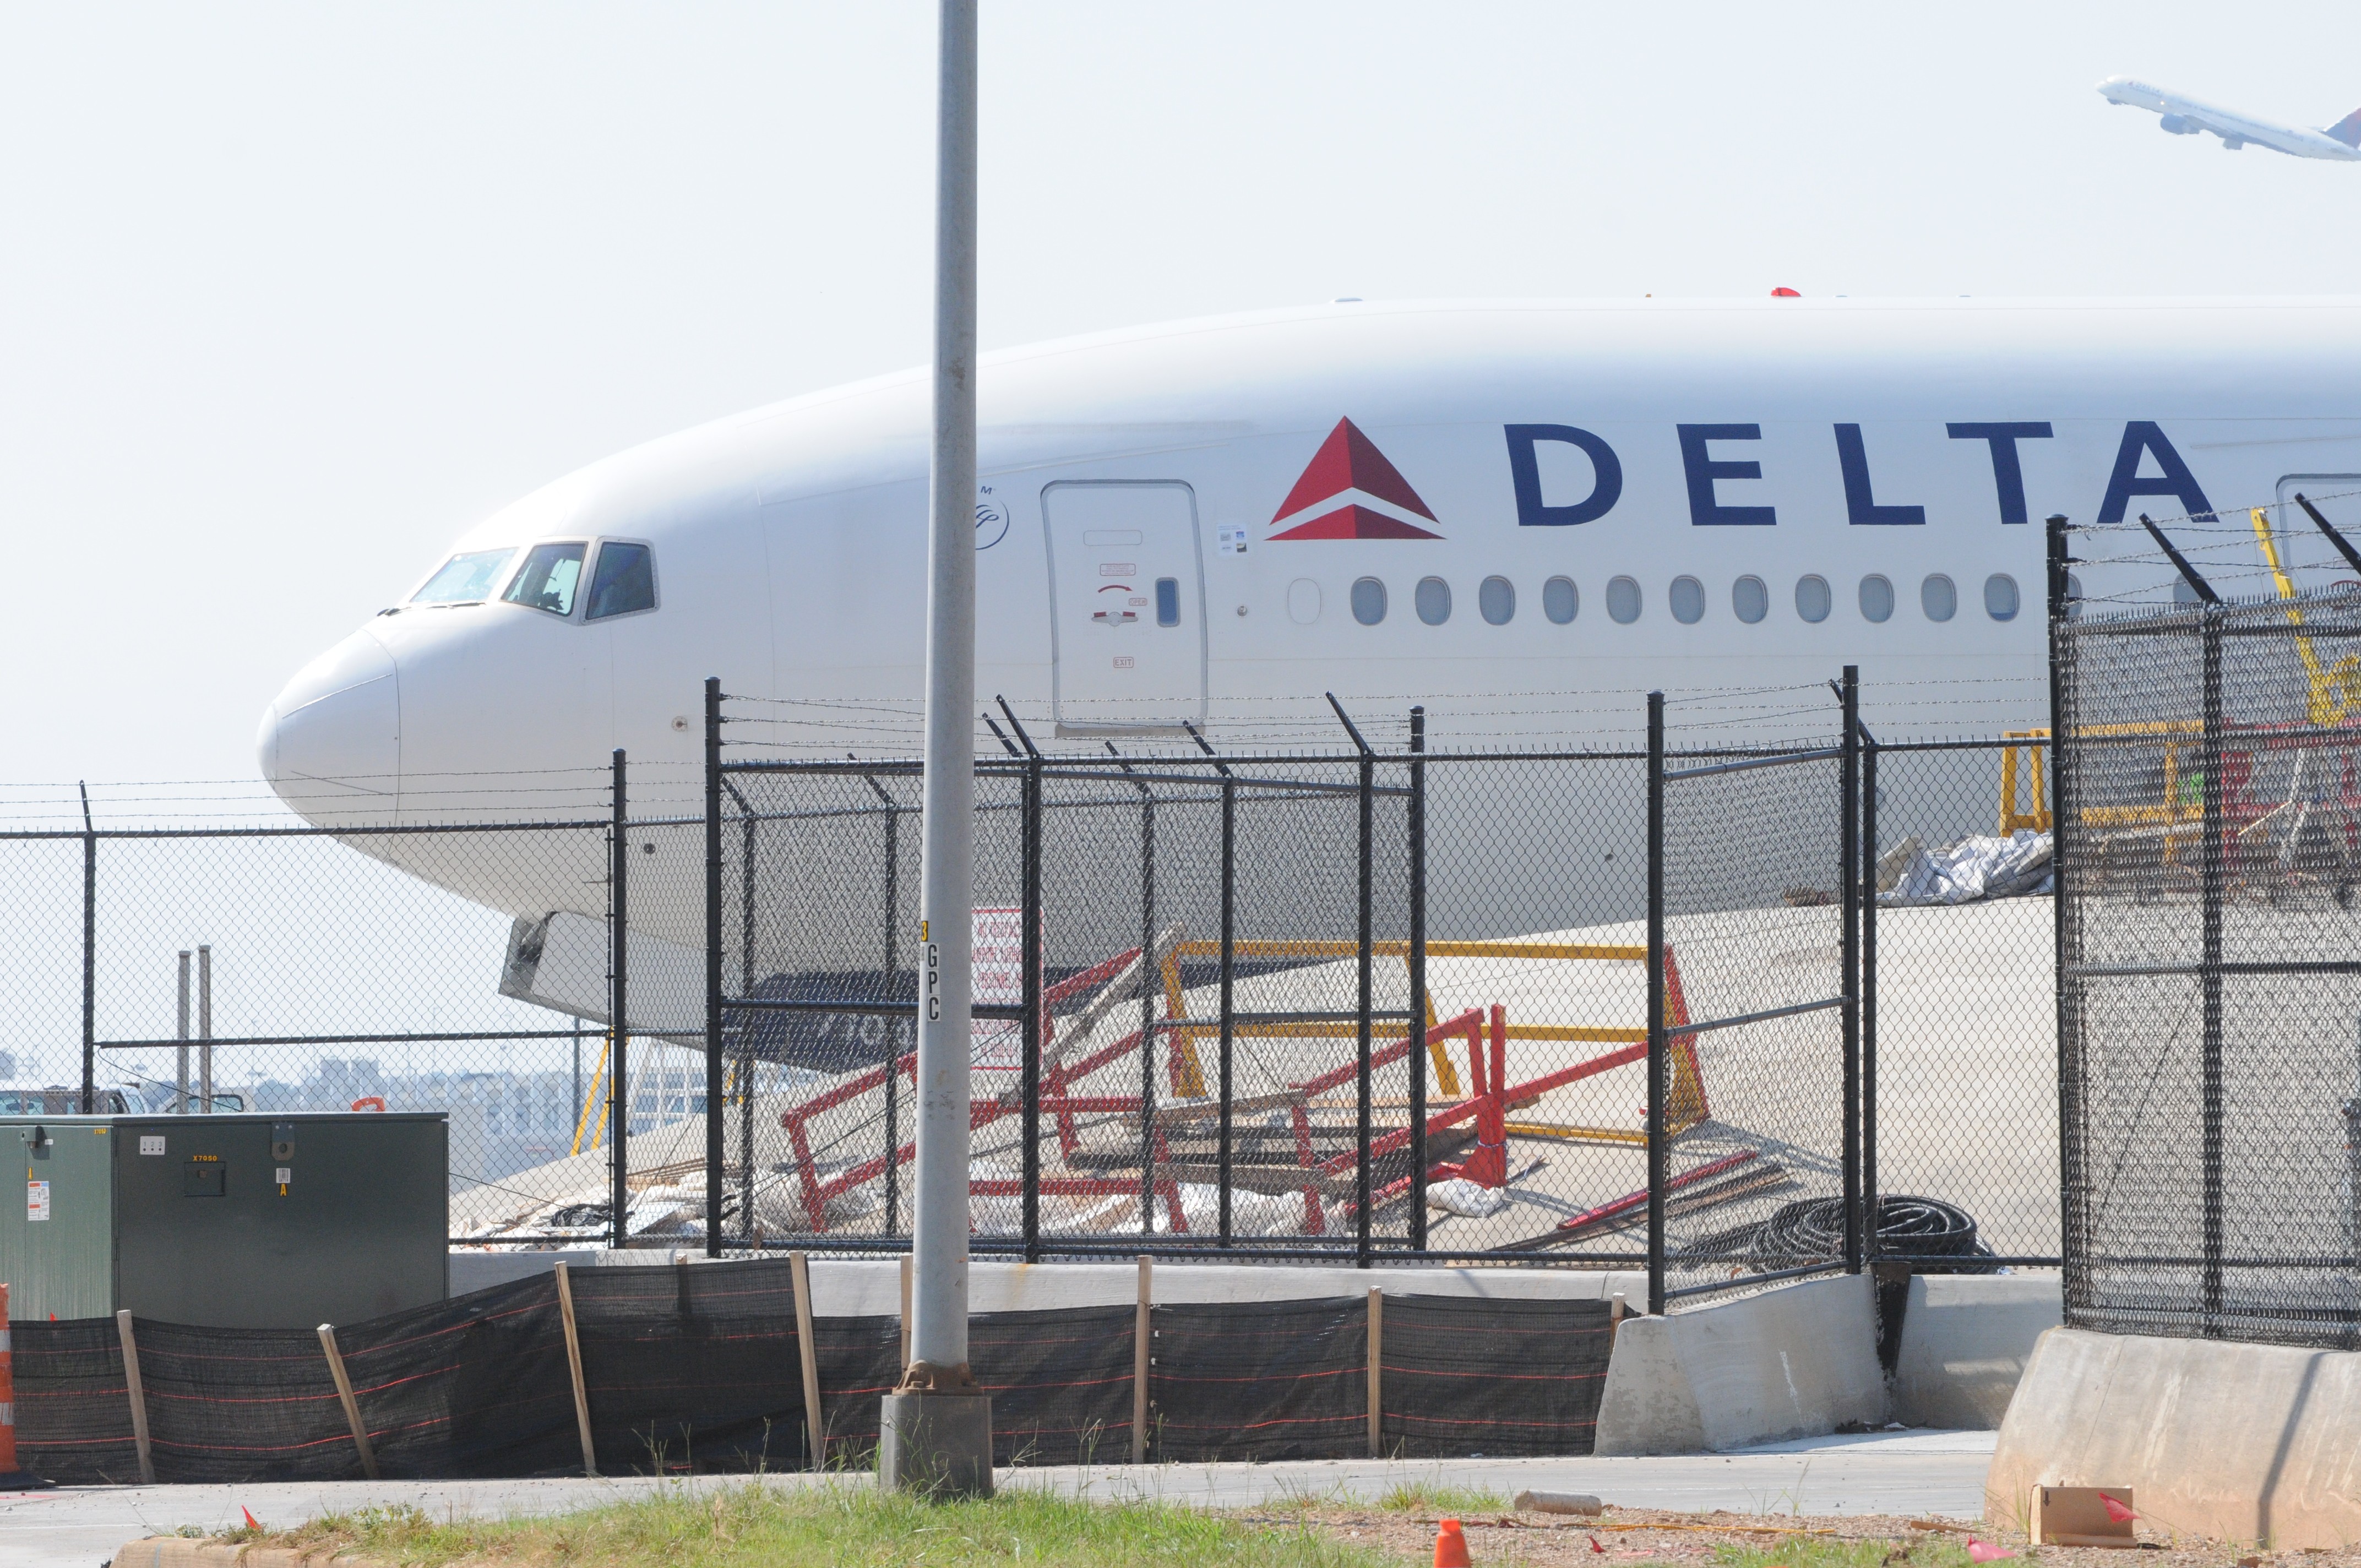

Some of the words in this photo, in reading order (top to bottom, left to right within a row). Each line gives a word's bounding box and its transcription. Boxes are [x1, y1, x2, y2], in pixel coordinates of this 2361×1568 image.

[1504, 421, 2219, 526] DELTA
[921, 921, 928, 941] 3
[280, 1183, 287, 1196] A
